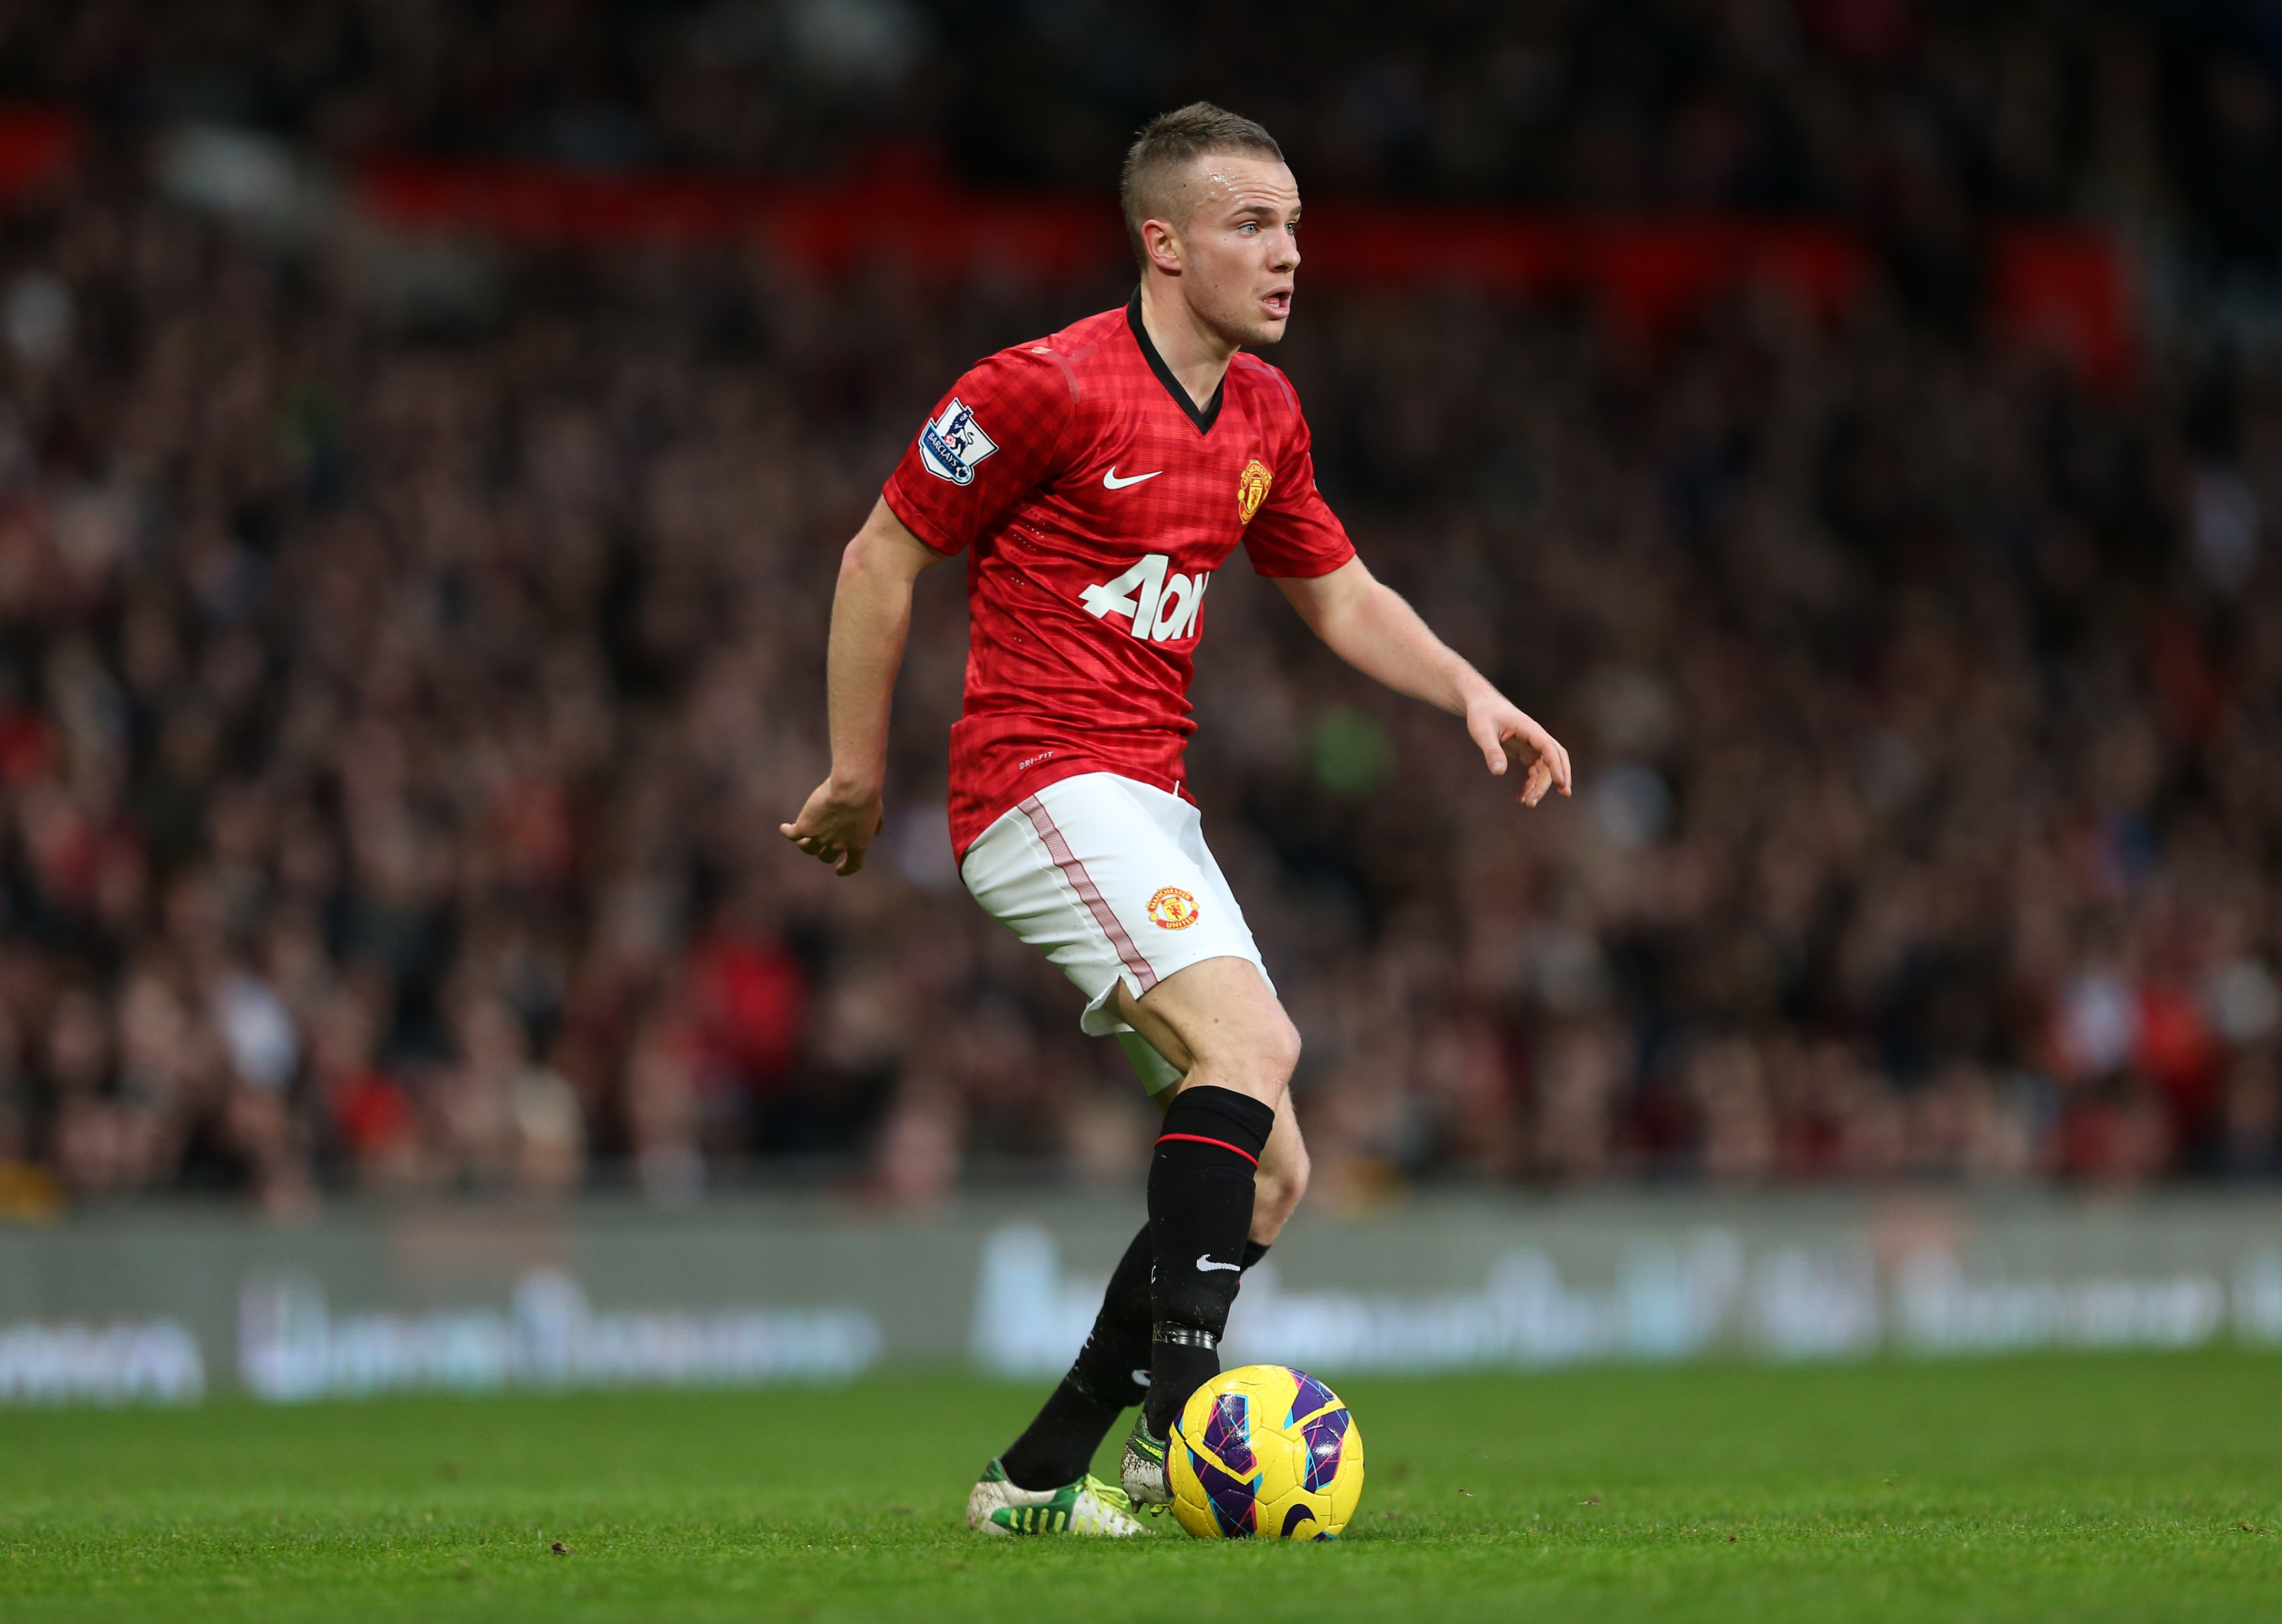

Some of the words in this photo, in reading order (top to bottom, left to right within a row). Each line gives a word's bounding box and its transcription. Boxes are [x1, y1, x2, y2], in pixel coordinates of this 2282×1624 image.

[928, 432, 959, 466] BARCLAYS
[1243, 464, 1270, 487] MANCHESTER
[1020, 751, 1053, 769] DRI-FIT
[1150, 889, 1191, 909] MANCHESTER
[1166, 915, 1195, 928] UNITED
